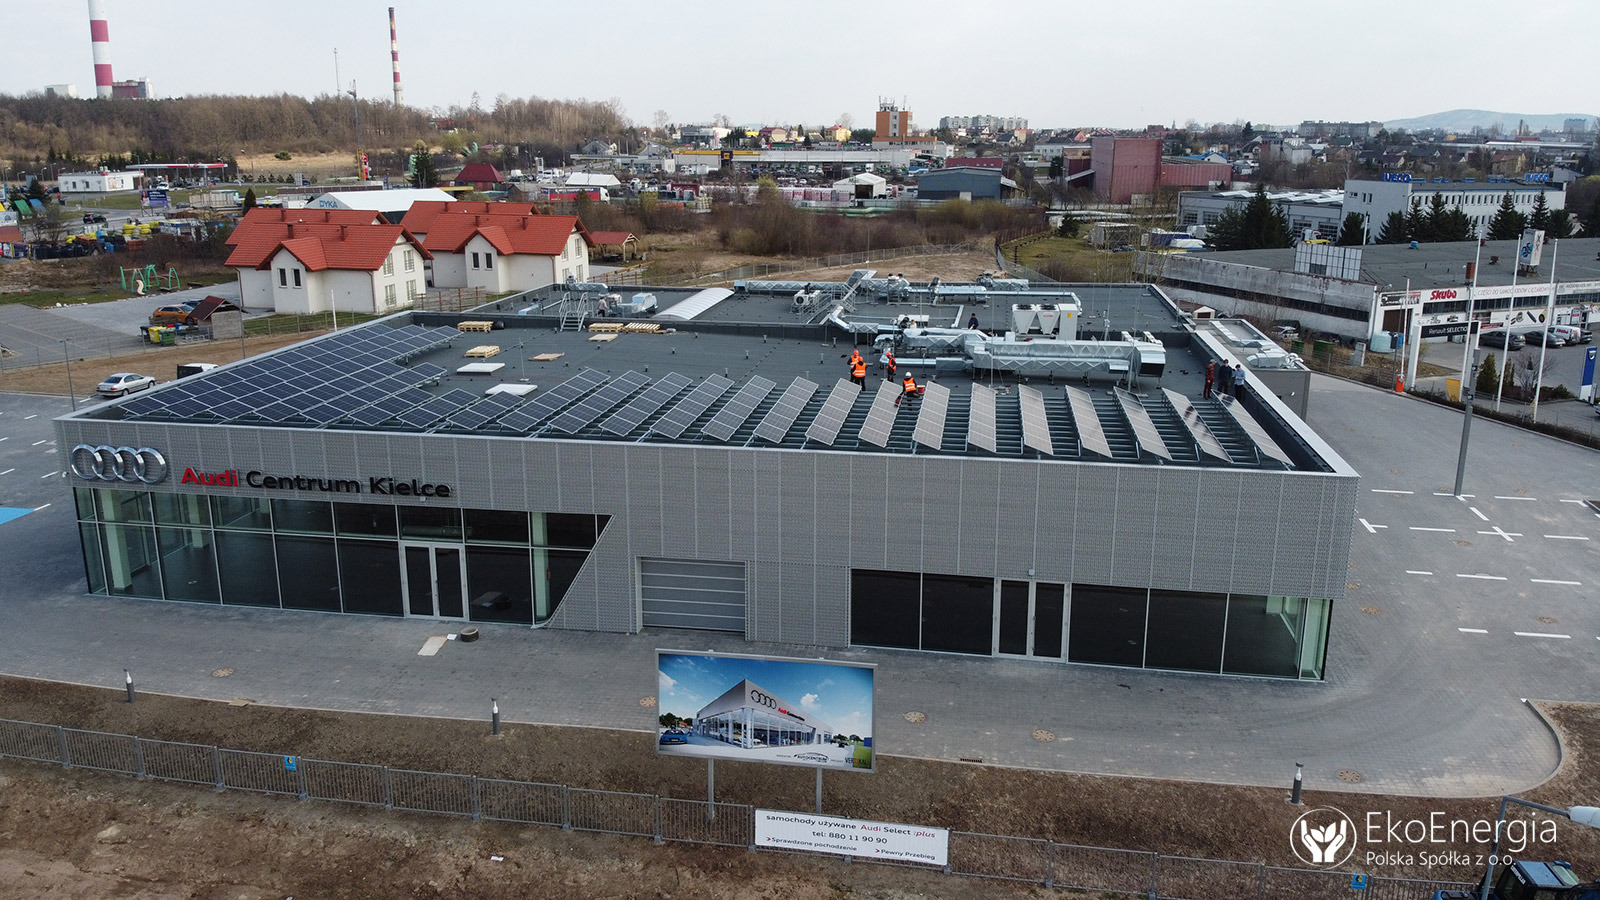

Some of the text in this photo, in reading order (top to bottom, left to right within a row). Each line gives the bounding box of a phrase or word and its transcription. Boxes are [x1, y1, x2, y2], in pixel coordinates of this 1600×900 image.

[1382, 172, 1411, 183] IVECO
[1525, 173, 1550, 182] IVECO
[320, 200, 338, 208] DYKA
[181, 467, 452, 498] Audi Centrum Kielce
[766, 815, 816, 825] samochody
[818, 820, 857, 829] używane
[883, 827, 911, 835] Select
[772, 837, 857, 851] Sprawdzone pochodzenie
[905, 850, 935, 860] Przebieg
